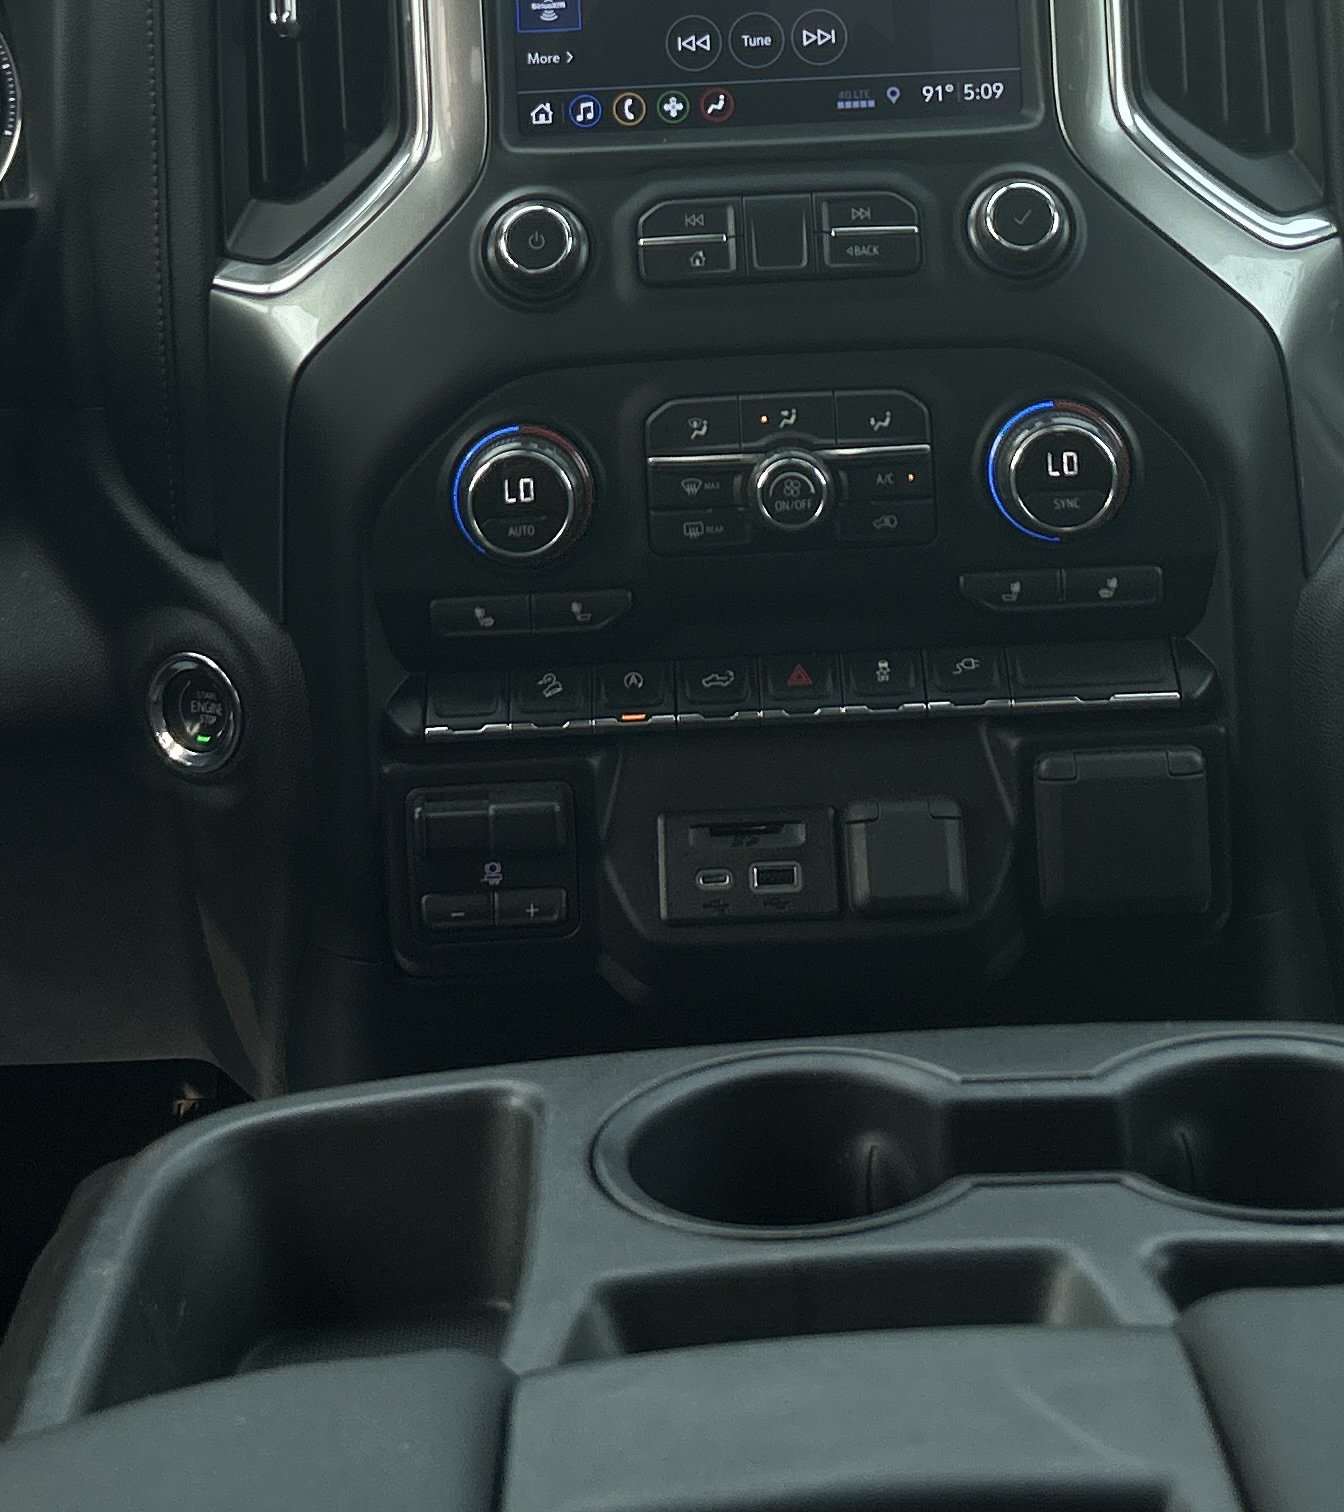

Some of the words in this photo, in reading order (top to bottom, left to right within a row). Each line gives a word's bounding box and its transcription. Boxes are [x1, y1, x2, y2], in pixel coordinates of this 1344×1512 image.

[741, 34, 772, 48] Tune
[527, 53, 561, 65] More
[922, 83, 954, 103] 91°
[963, 83, 1005, 101] 5:09
[855, 245, 880, 256] BACK
[1047, 451, 1079, 477] LO
[876, 473, 895, 486] A/C
[504, 477, 535, 504] LO
[774, 498, 814, 512] ON/OFF
[508, 524, 536, 537] AUTO
